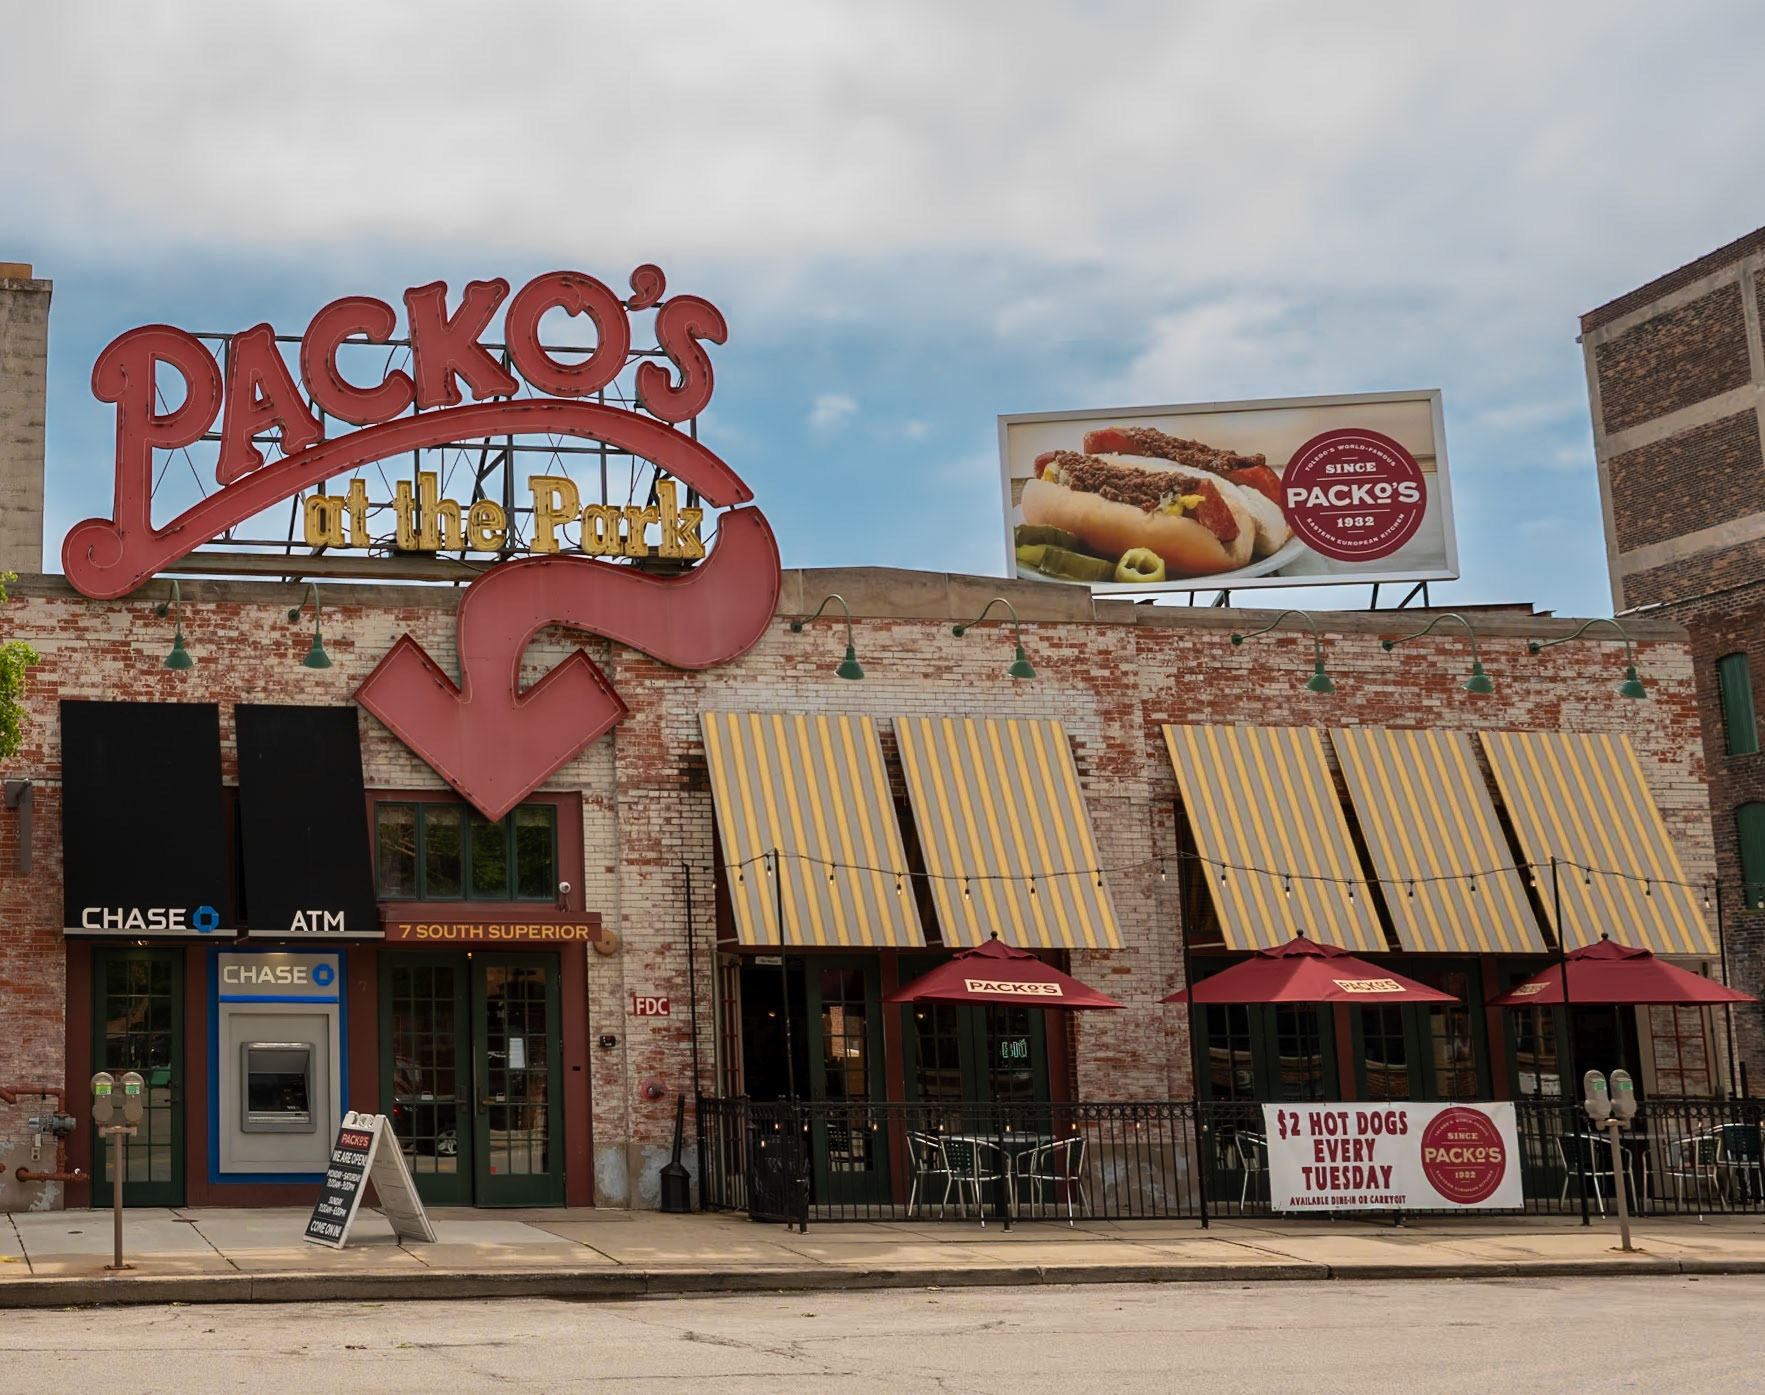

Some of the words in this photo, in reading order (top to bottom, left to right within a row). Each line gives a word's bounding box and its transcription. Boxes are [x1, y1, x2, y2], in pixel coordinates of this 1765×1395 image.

[62, 264, 728, 600] PACKO'S
[1305, 447, 1335, 472] TOLEDO'S
[1337, 444, 1396, 467] WORLD-FAMOUS
[1325, 462, 1376, 474] SINCE
[1286, 481, 1420, 508] PACKO'S
[303, 479, 370, 549] at
[394, 472, 507, 552] the
[528, 476, 705, 559] Park
[1337, 516, 1374, 528] 1932
[1307, 517, 1336, 541] EASTERN
[1337, 536, 1378, 546] EUROPEAN
[1380, 513, 1405, 539] KITCHEN
[82, 907, 187, 930] CHASE
[290, 910, 345, 932] ATM
[399, 925, 411, 938] 7
[416, 924, 483, 939] SOUTH
[488, 924, 589, 939] SUPERIOR
[223, 966, 308, 984] CHASE
[969, 981, 1058, 994] PACKO'S
[636, 998, 668, 1015] FDC
[1277, 1109, 1301, 1140] $2
[1308, 1112, 1349, 1136] HOT
[1356, 1111, 1408, 1135] DOGS
[1447, 1132, 1479, 1140] SINCE
[332, 1150, 342, 1162] WE
[340, 1151, 352, 1163] ARE
[1314, 1138, 1375, 1162] EVERY
[1424, 1147, 1502, 1163] PACKO'S
[1302, 1165, 1392, 1190] TUESDAY
[1290, 1196, 1329, 1206] AVAILABLE
[310, 1220, 327, 1233] COME
